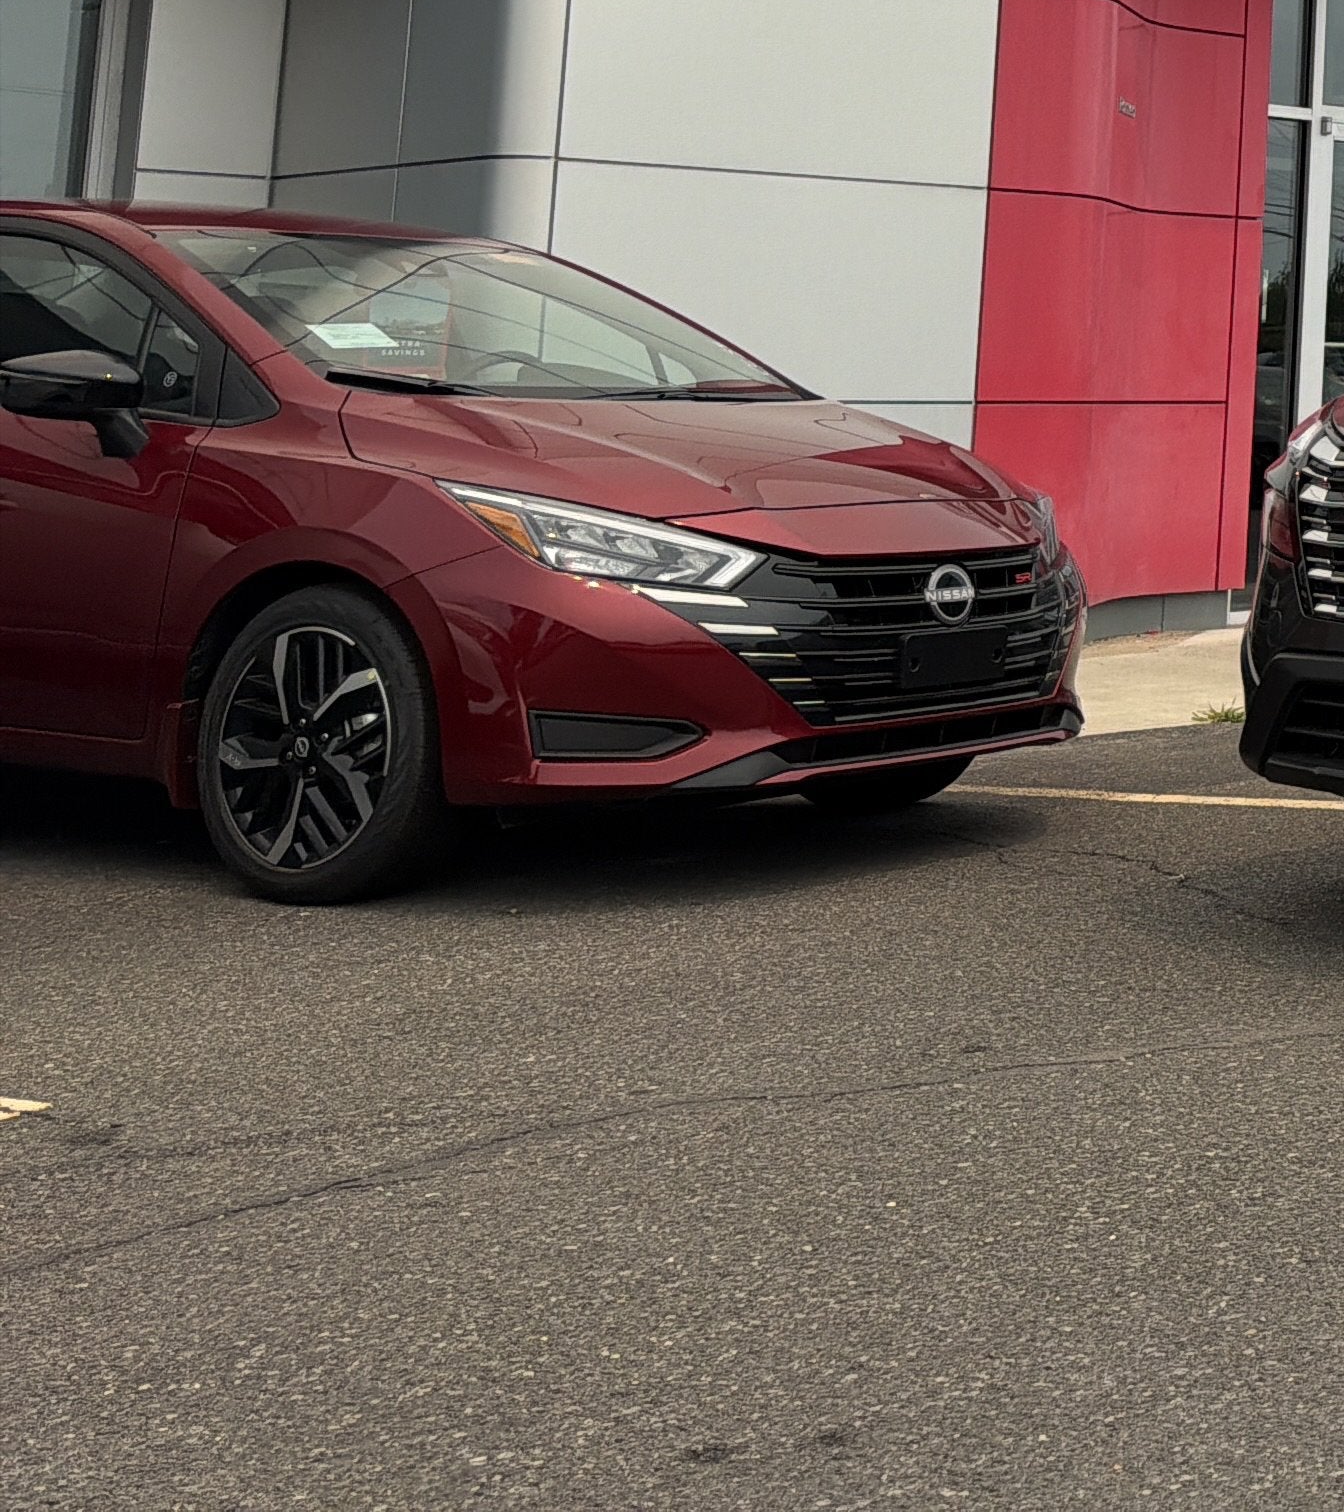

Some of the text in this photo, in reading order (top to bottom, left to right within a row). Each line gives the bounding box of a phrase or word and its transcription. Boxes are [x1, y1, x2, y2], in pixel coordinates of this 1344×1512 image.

[381, 349, 425, 357] SAVINGS
[1014, 572, 1032, 584] SR
[925, 589, 976, 601] NISSAN
